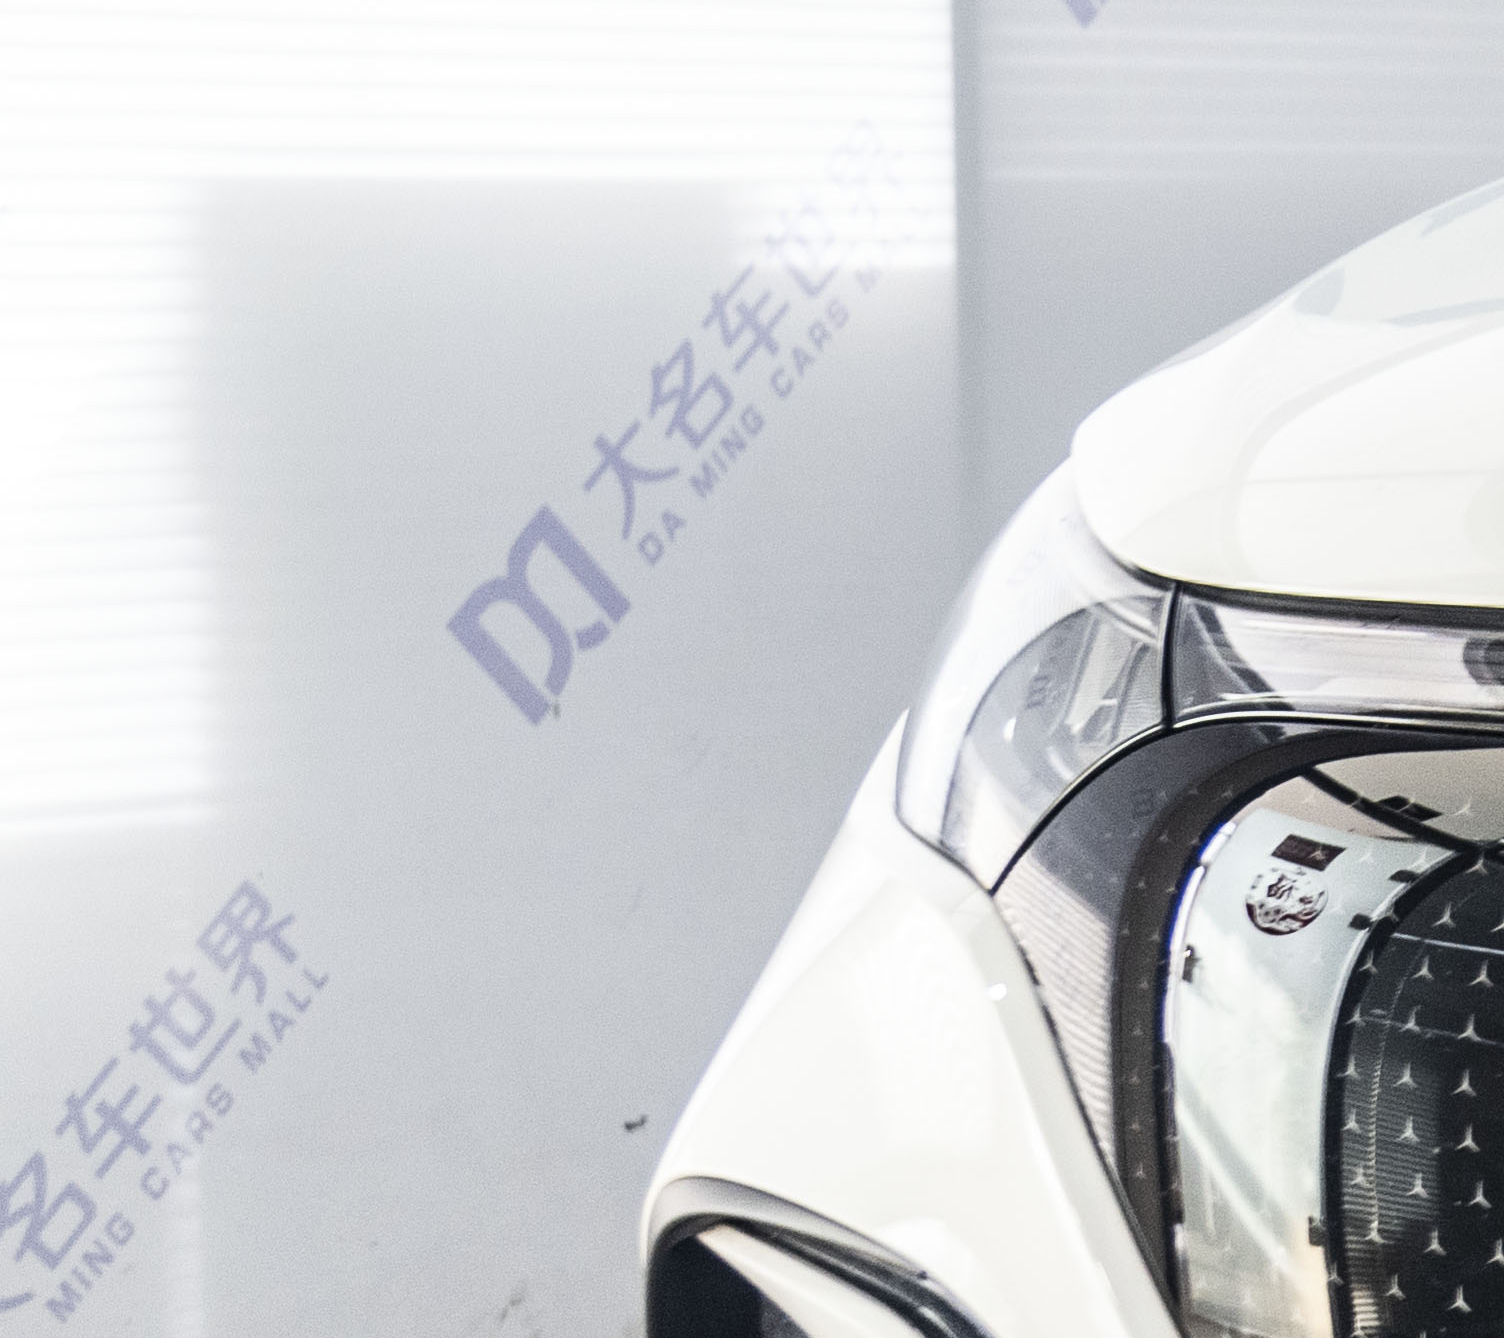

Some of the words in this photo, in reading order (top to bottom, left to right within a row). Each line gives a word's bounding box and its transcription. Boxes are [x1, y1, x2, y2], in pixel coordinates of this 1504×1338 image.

[637, 509, 687, 565] DA
[690, 405, 765, 499] MING
[770, 299, 850, 398] CARS
[46, 1211, 136, 1323] MING
[140, 1081, 235, 1201] CARS
[239, 967, 330, 1072] MALL
